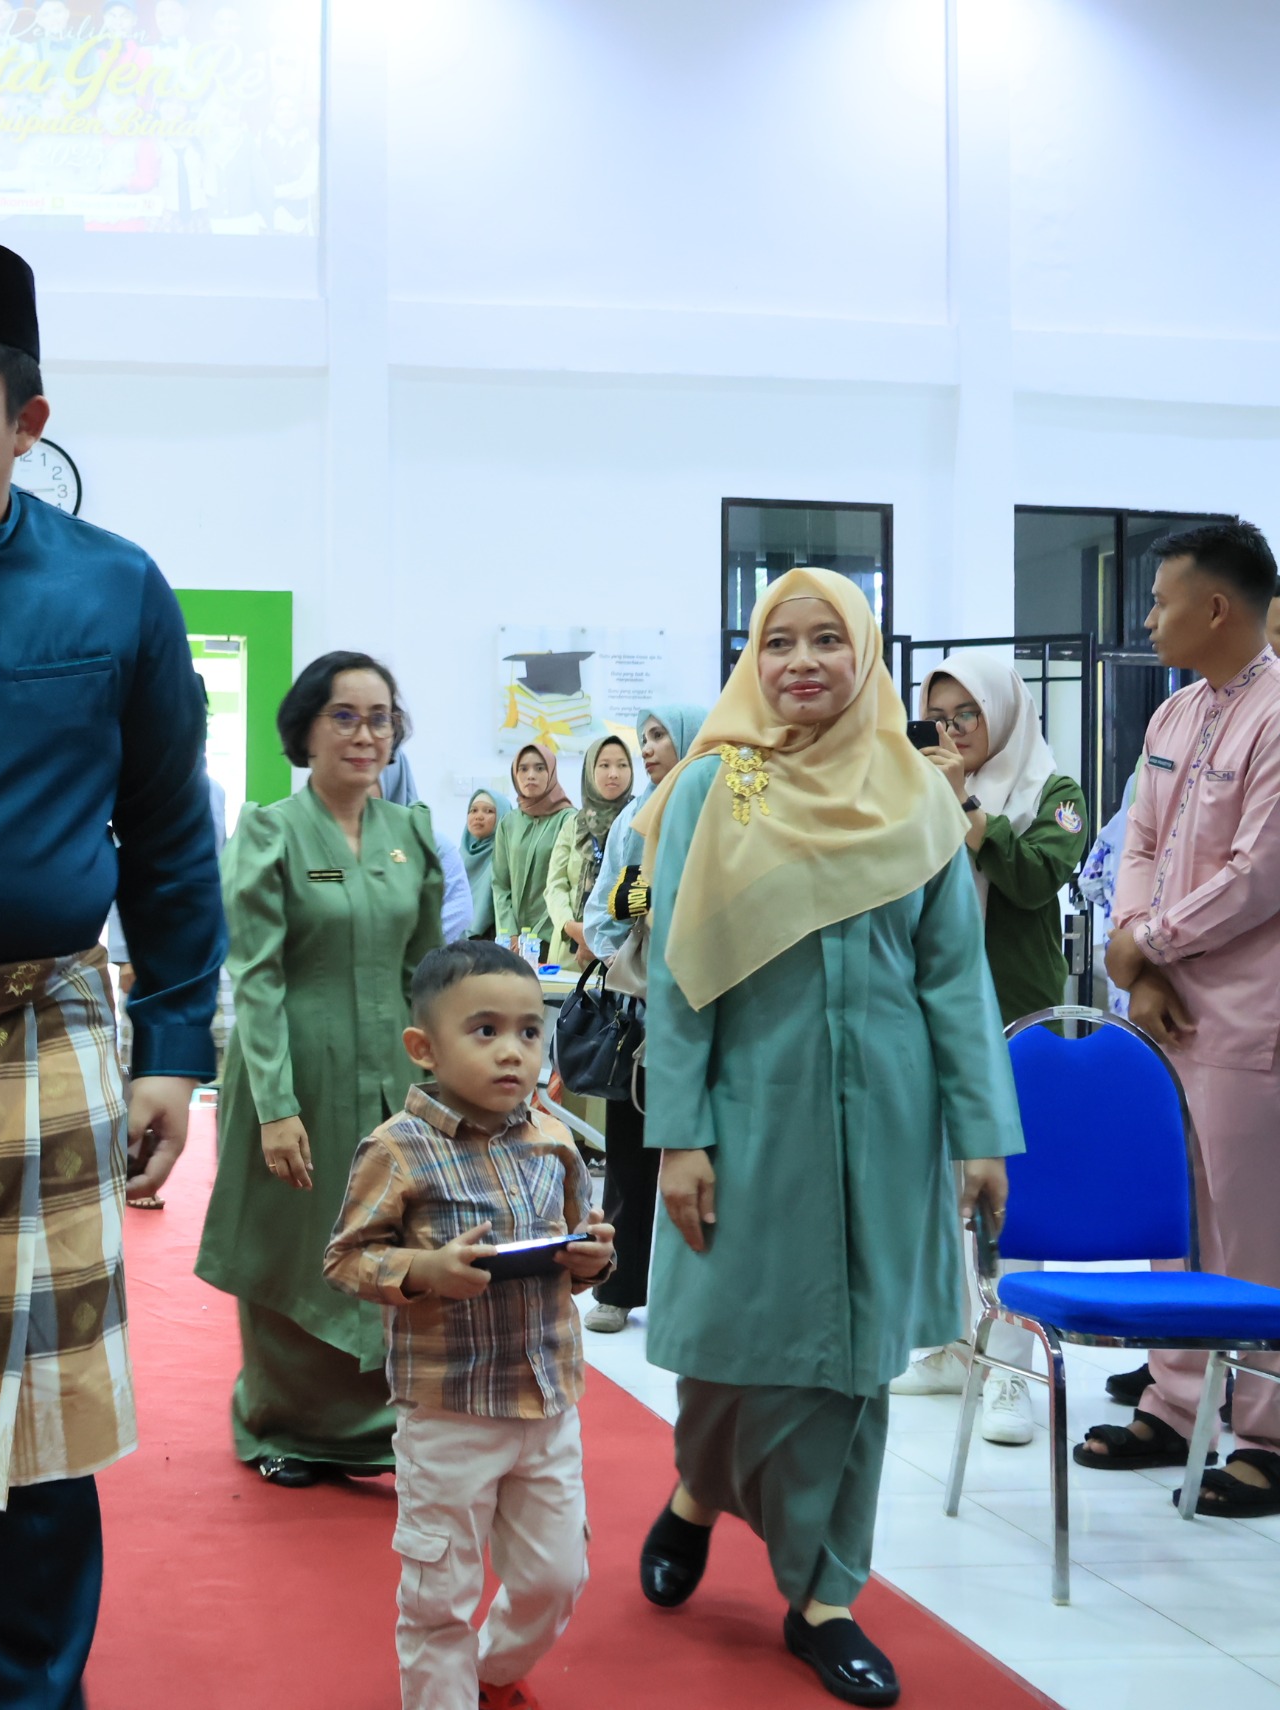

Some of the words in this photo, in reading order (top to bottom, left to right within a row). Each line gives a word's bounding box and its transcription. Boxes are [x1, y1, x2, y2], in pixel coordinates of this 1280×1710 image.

[61, 35, 266, 112] GenRe
[40, 452, 46, 467] 1
[52, 466, 62, 480] 2
[57, 484, 68, 498] 3
